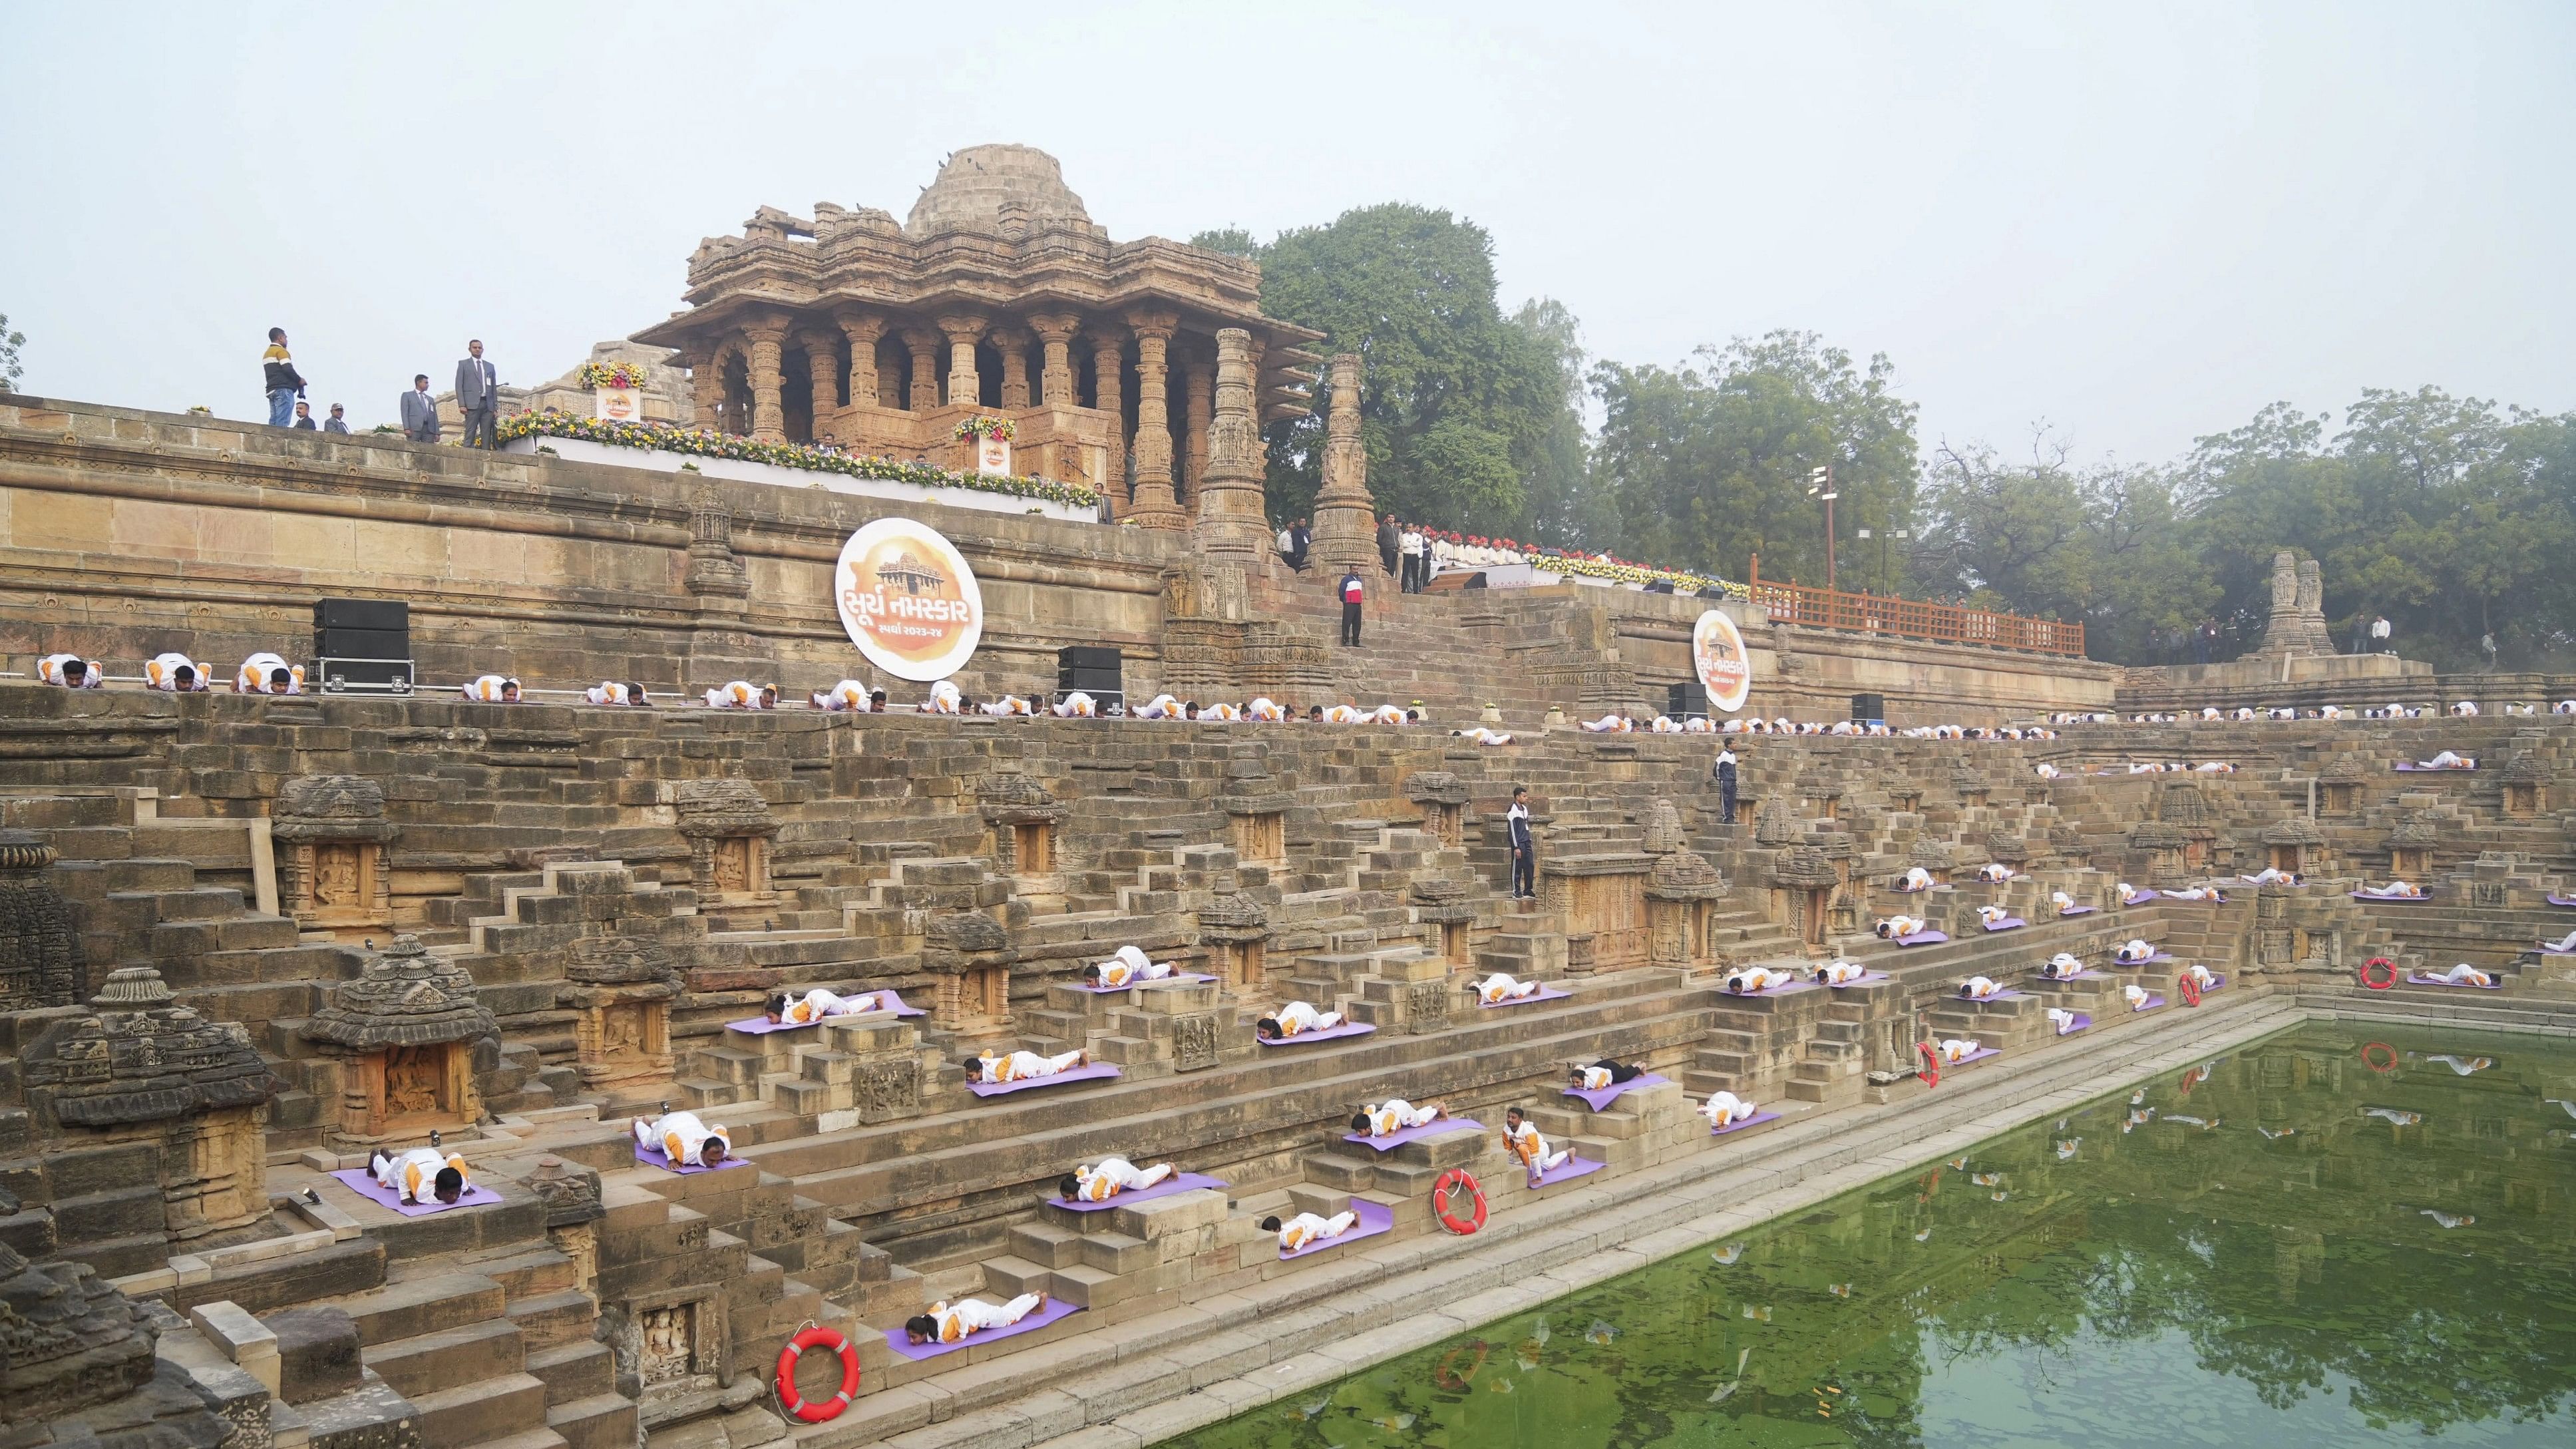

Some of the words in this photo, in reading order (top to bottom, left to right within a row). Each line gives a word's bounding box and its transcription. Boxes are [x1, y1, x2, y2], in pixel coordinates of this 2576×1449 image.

[844, 584, 885, 626] સૂર્ય
[889, 596, 970, 622] નમસ્કાર
[903, 627, 942, 637] ૨૦૨૩-૨૪
